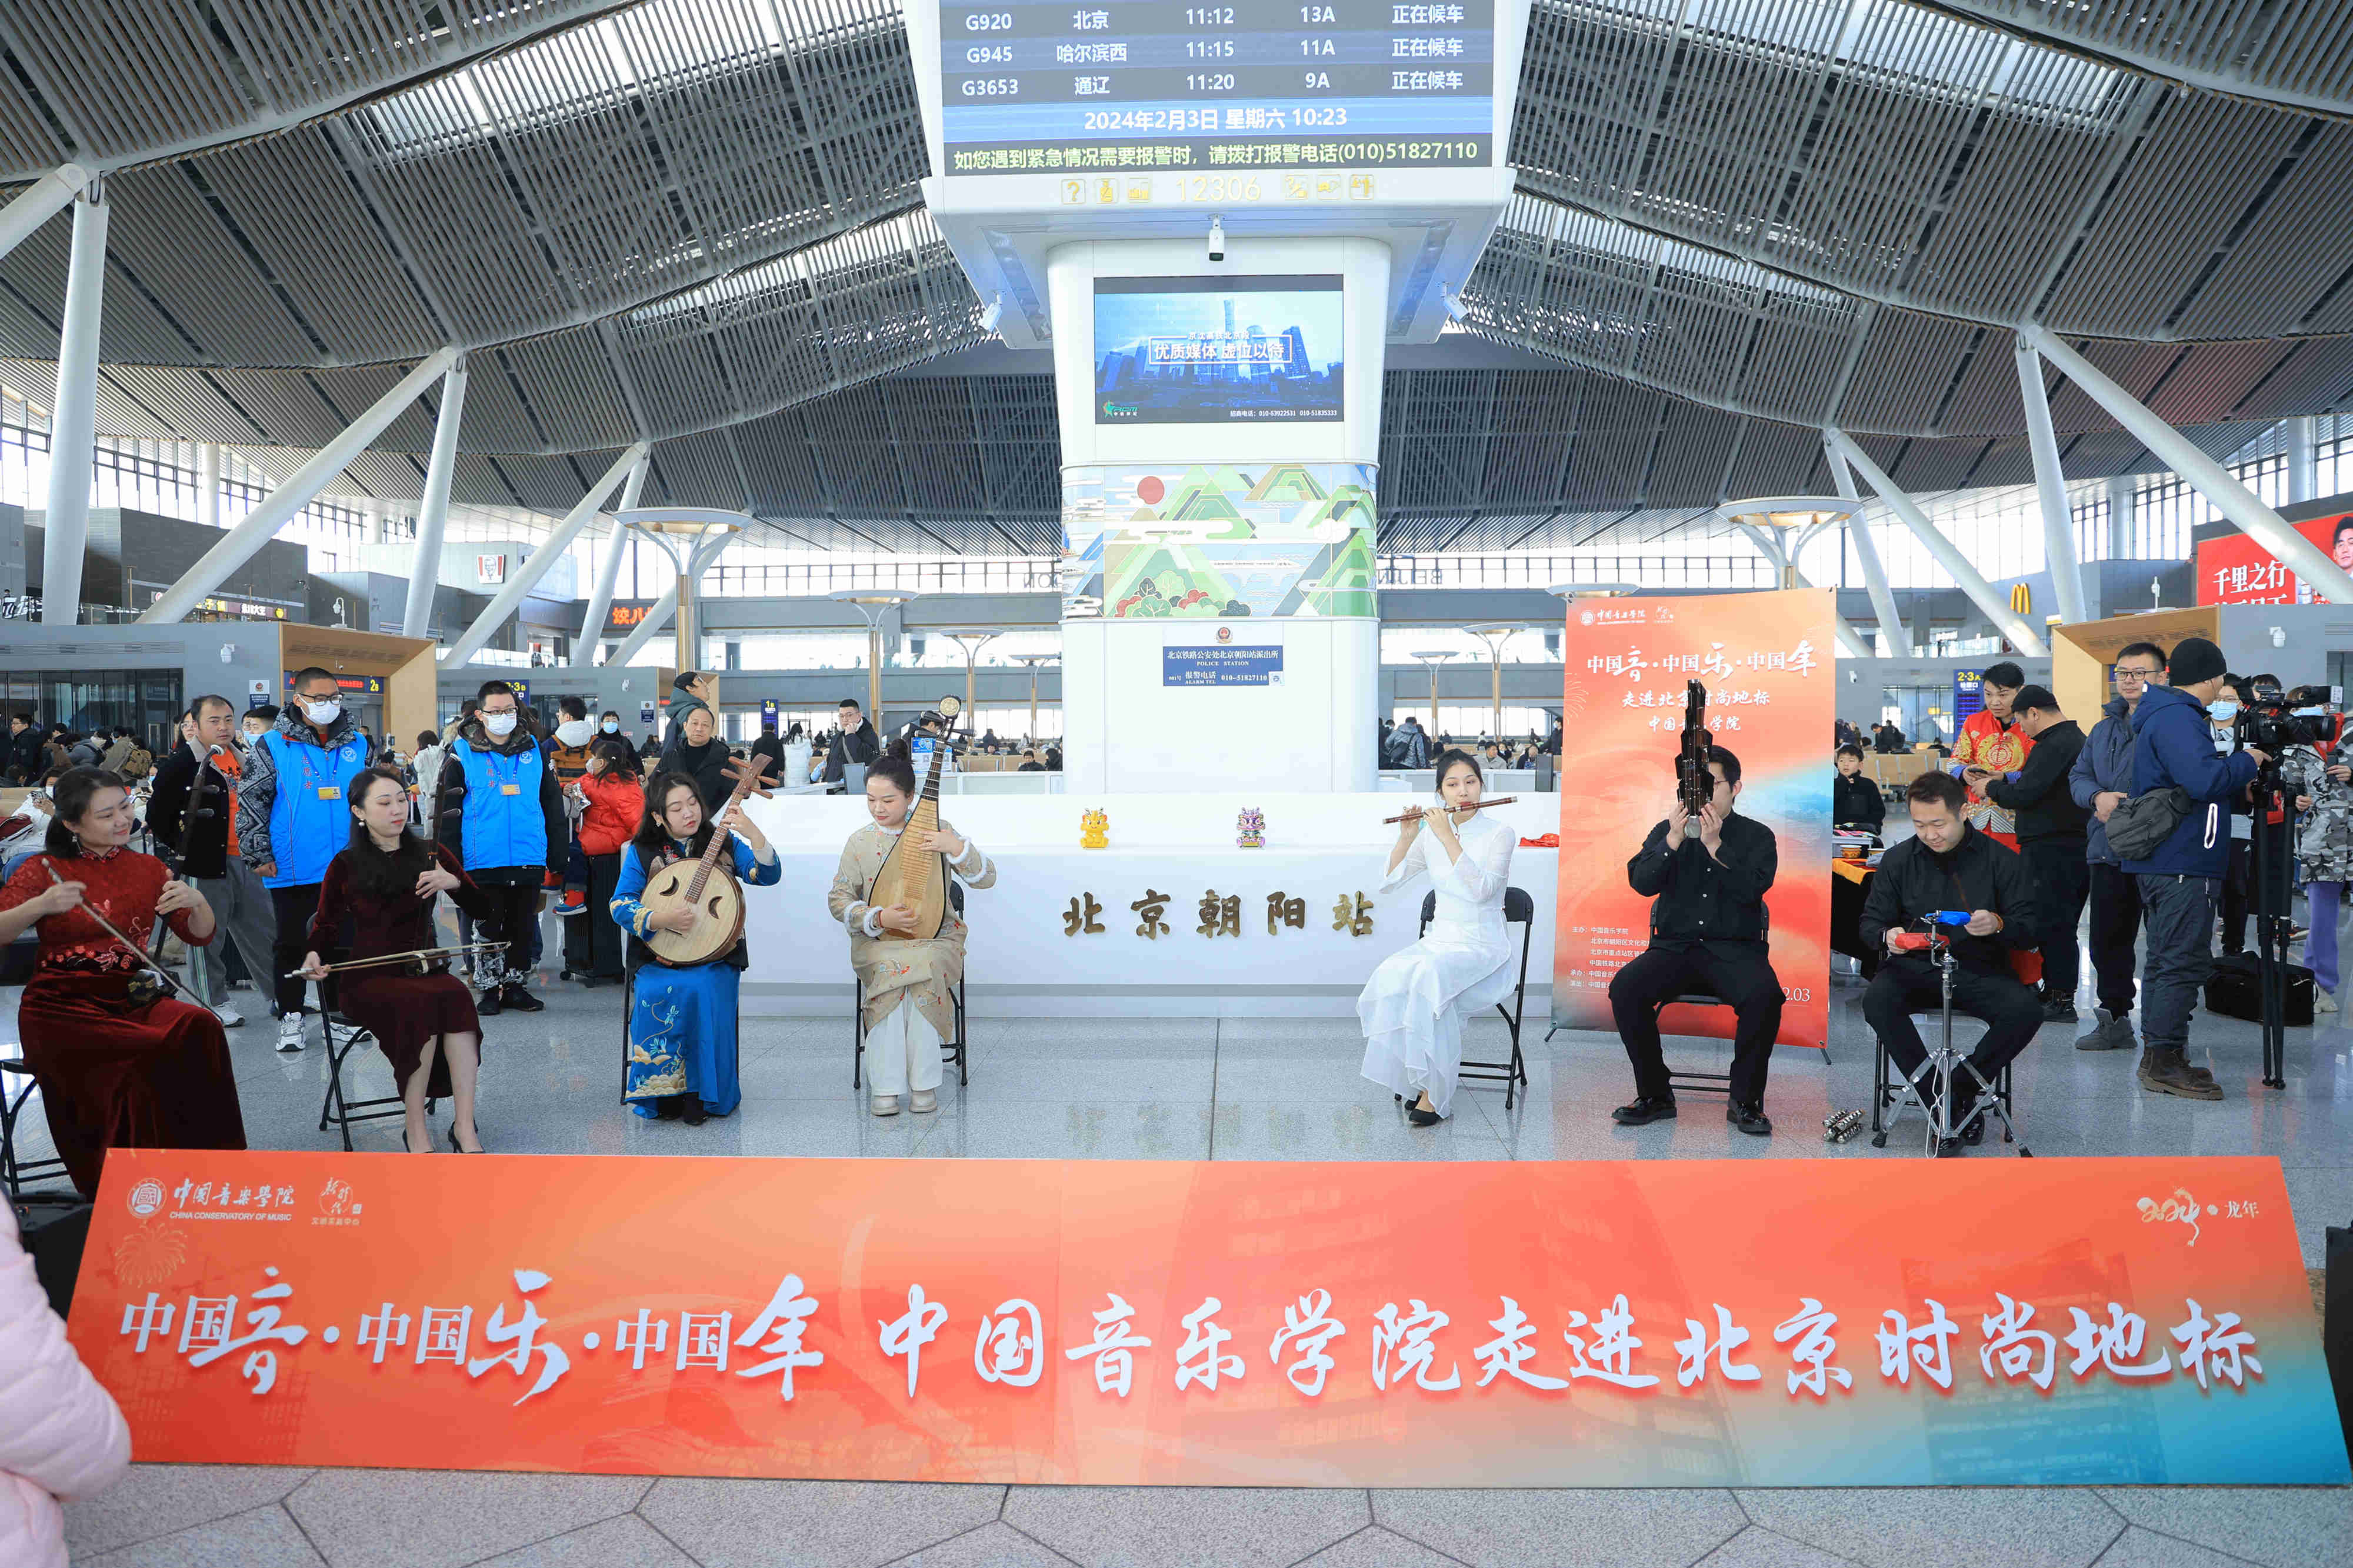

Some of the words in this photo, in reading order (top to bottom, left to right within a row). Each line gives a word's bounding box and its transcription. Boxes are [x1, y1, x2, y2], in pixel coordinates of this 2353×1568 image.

[965, 14, 1012, 30] G920
[1073, 11, 1109, 29] 北京
[1186, 8, 1234, 24] 11:12
[1301, 6, 1336, 22] 13A
[1392, 5, 1464, 24] 正在候车
[966, 46, 1012, 63] G945
[1056, 44, 1127, 62] 哈尔滨西
[1187, 41, 1234, 57] 11:15
[1301, 39, 1335, 55] 11A
[1392, 38, 1464, 56] 正在候车
[962, 79, 1018, 96] G3653
[1074, 76, 1110, 95] 通辽
[1187, 74, 1234, 90] 11:20
[1305, 72, 1329, 88] 9A
[1392, 71, 1463, 89] 正在候车
[1084, 109, 1218, 131] 2024年2月3日
[1225, 108, 1285, 129] 星期六
[1292, 108, 1347, 126] 10:23
[1176, 176, 1262, 201] 12306
[1154, 343, 1217, 359] 优质媒体
[1221, 342, 1285, 359] 虚位以待
[2212, 559, 2288, 596] 千里之行
[1185, 671, 1217, 679] 报警电话
[1649, 715, 1741, 732] 中国学院
[1062, 889, 1374, 940] 北京朝阳站
[194, 1212, 255, 1220] CONSERVATORY
[268, 1213, 292, 1222] MUSIC
